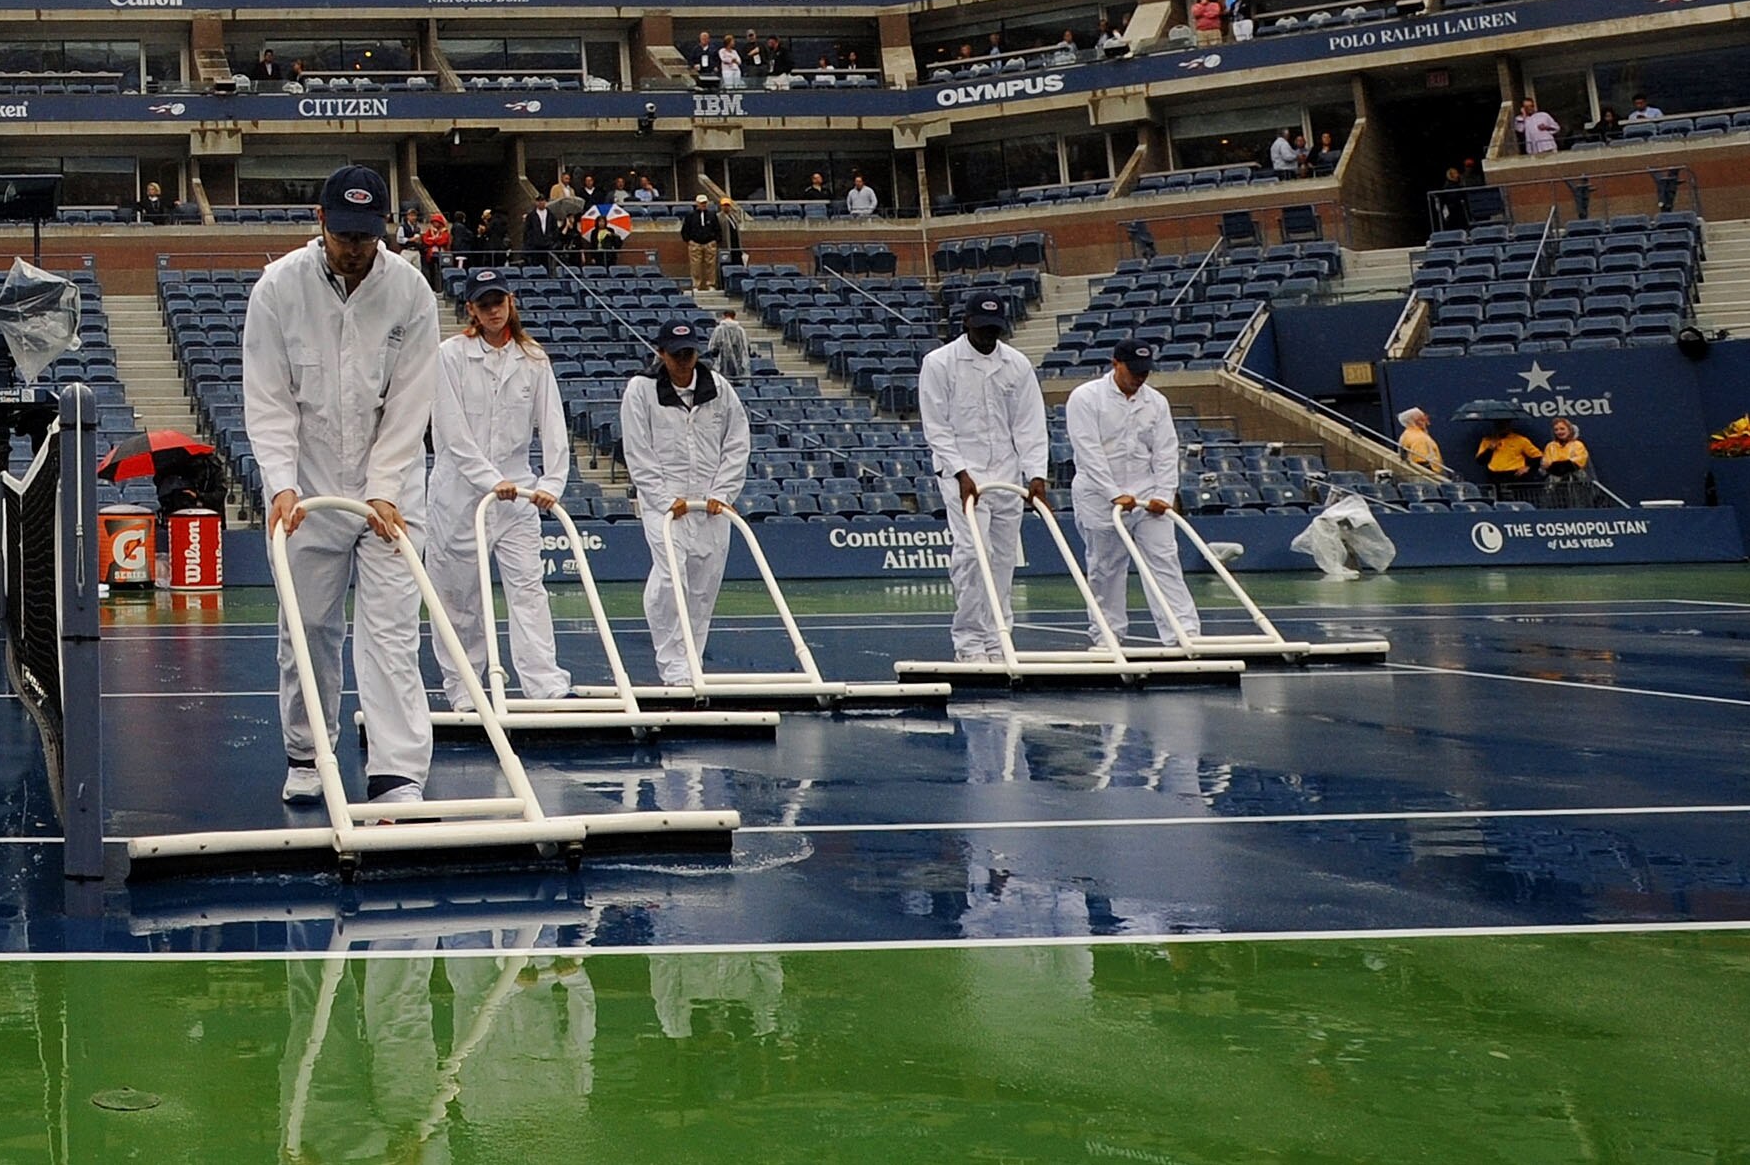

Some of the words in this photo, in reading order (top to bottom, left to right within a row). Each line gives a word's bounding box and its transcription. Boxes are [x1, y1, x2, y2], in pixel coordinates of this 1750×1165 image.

[1329, 31, 1376, 51] POLO
[1381, 21, 1440, 44] RALPH
[1444, 10, 1518, 35] LAUREN
[936, 74, 1064, 107] OLYMPUS
[298, 97, 388, 117] CITIZEN
[693, 94, 743, 116] IBM
[1522, 396, 1612, 418] neken
[829, 526, 953, 547] Continent
[1503, 523, 1534, 538] THE
[1536, 520, 1648, 538] COSMOPOLITAN
[112, 529, 146, 570] G
[184, 518, 202, 585] Wilson
[1547, 540, 1556, 550] of
[1559, 539, 1579, 549] LAS
[1581, 537, 1614, 549] VEGAS
[882, 548, 951, 569] Airlin
